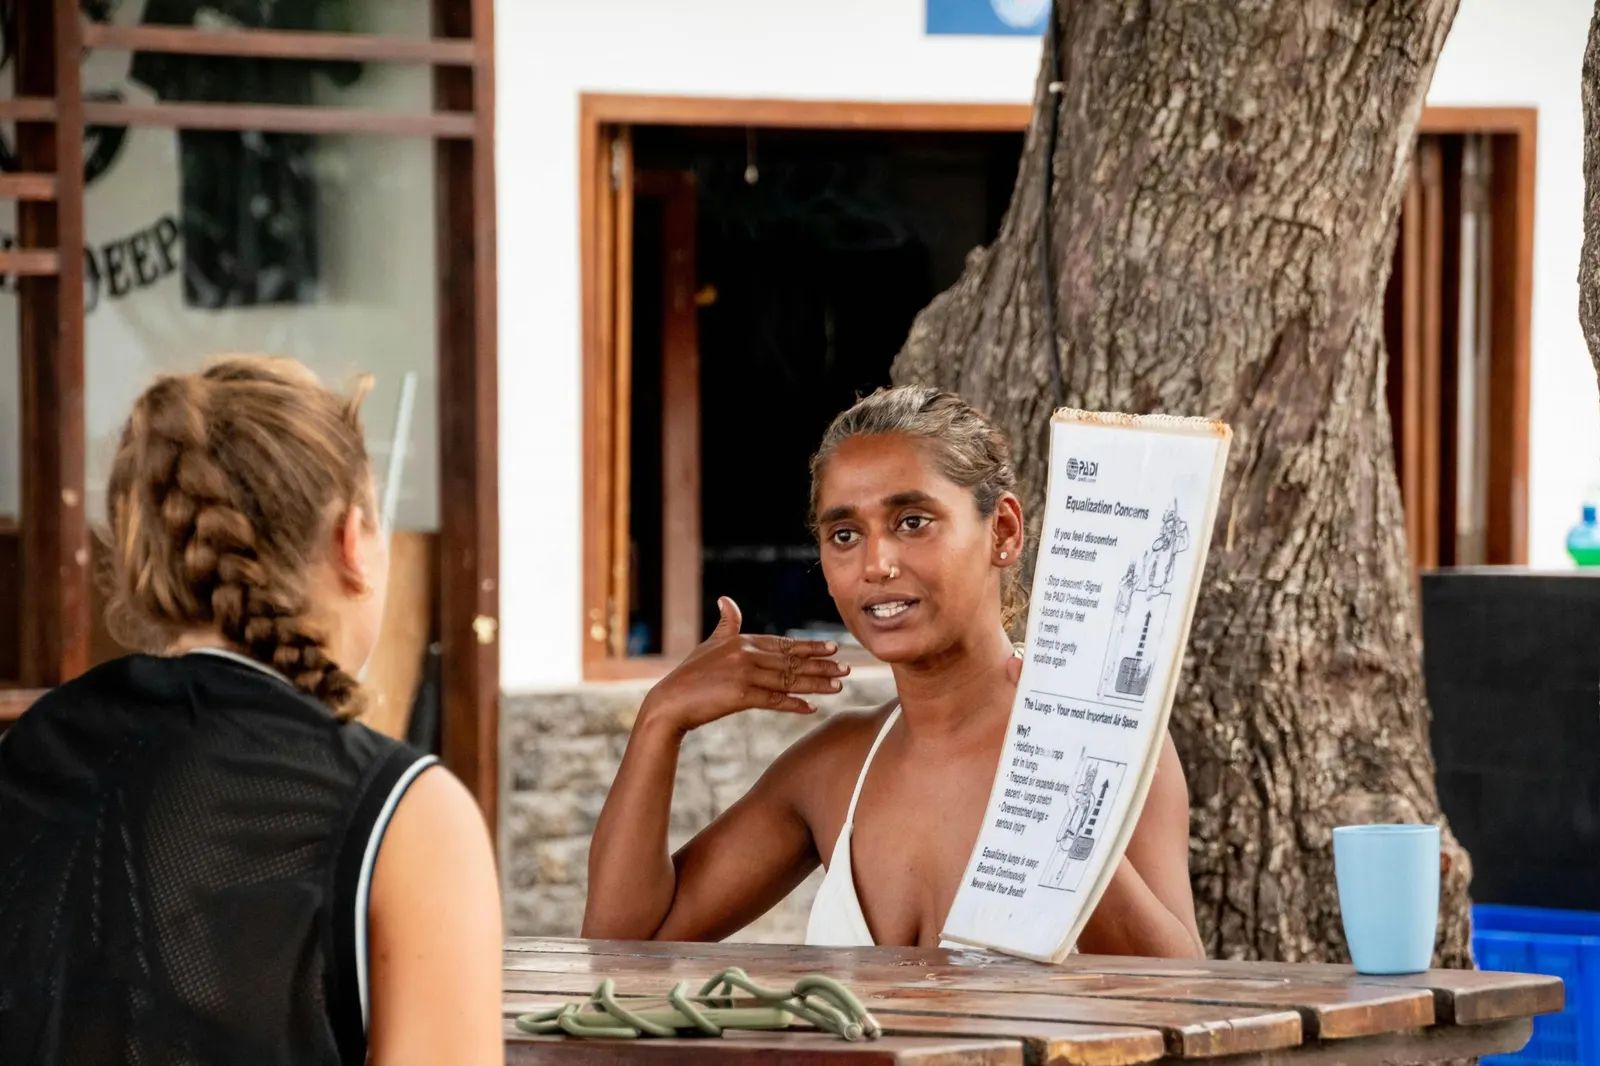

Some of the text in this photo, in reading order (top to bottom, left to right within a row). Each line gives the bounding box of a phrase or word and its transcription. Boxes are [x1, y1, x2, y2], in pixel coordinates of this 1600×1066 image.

[1078, 461, 1098, 477] PADI
[1066, 496, 1150, 520] Equalization Concerns
[1054, 528, 1118, 546] If you feel discomfort
[1051, 544, 1070, 558] during
[1046, 575, 1060, 589] Stop
[1044, 591, 1099, 609] the PADI Professional
[1041, 606, 1059, 619] Ascend
[1064, 609, 1074, 620] few
[1075, 611, 1086, 623] feet
[1036, 637, 1054, 651] Attempt
[1060, 642, 1078, 656] gently
[1033, 653, 1067, 669] equalize again
[1024, 698, 1034, 710] The
[1034, 700, 1052, 715] Lungs
[1056, 703, 1070, 716] Your
[1071, 708, 1085, 719] most
[1086, 710, 1113, 724] Important
[1113, 714, 1122, 726] Air
[1122, 715, 1138, 730] Space
[1016, 724, 1031, 738] Why?
[1016, 740, 1034, 756] Holding
[1012, 756, 1020, 767] air
[1024, 759, 1039, 773] lungs
[1010, 771, 1028, 786] Trapped
[1035, 779, 1054, 791] expands
[1054, 782, 1069, 796] during
[1004, 788, 1021, 799] ascent
[1024, 792, 1036, 805] lungs
[1036, 794, 1052, 806] stretch
[1000, 802, 1032, 818] Overstretched
[1032, 810, 1044, 823] lungs
[995, 818, 1026, 836] serious injury
[982, 846, 1008, 864] Equalizing
[1008, 852, 1020, 865] lungs
[976, 862, 996, 876] Breathe
[970, 877, 1026, 898] Never Hold Your Breath!
